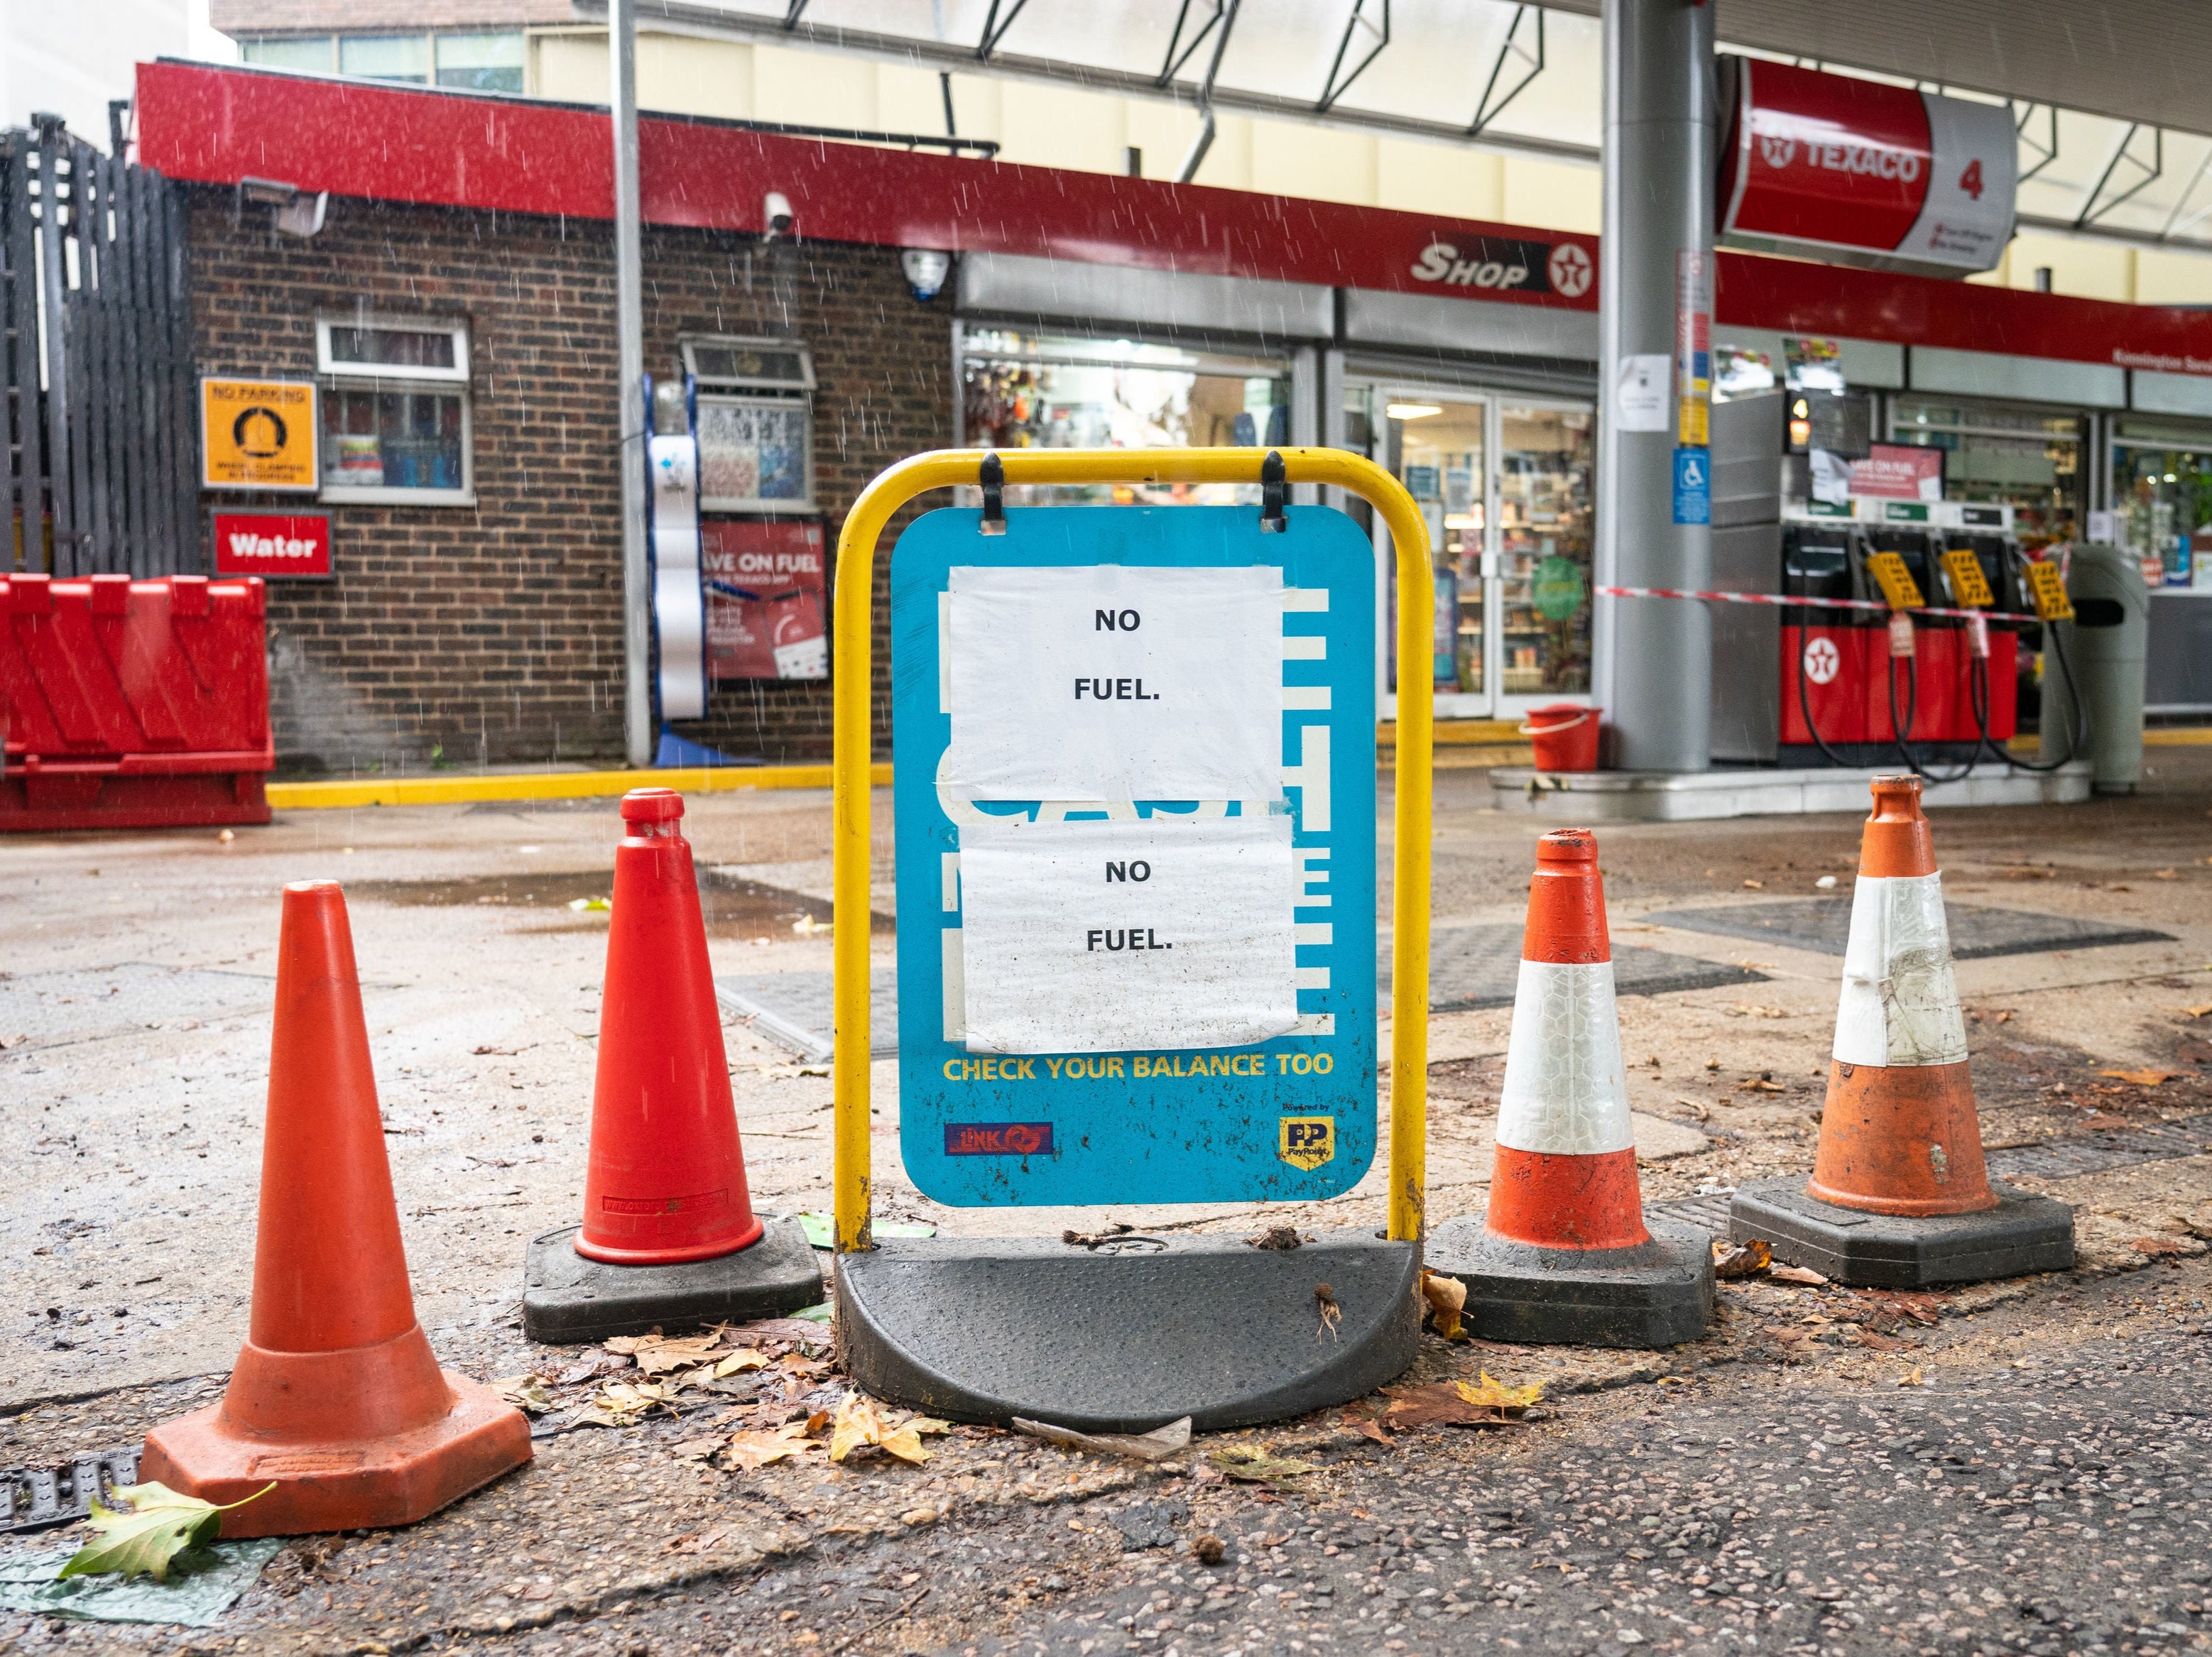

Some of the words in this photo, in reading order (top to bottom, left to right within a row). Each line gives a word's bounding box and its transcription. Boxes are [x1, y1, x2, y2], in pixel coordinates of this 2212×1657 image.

[1807, 141, 1919, 183] TEXACO
[1958, 158, 1984, 201] 4
[1410, 242, 1530, 290] SHOP
[229, 532, 317, 559] Water
[738, 552, 773, 573] ON
[776, 552, 820, 573] FUEL
[1094, 609, 1140, 632] NO
[1074, 678, 1160, 700] FUEL.
[1105, 860, 1151, 882] NO
[1086, 929, 1172, 951] FUEL.
[943, 1057, 1036, 1081] CHECK
[1045, 1056, 1124, 1080] YOUR
[1133, 1054, 1265, 1078] BALANCE
[1275, 1053, 1333, 1075] TOO
[1320, 1103, 1329, 1112] by
[1287, 1147, 1327, 1156] PayPoint
